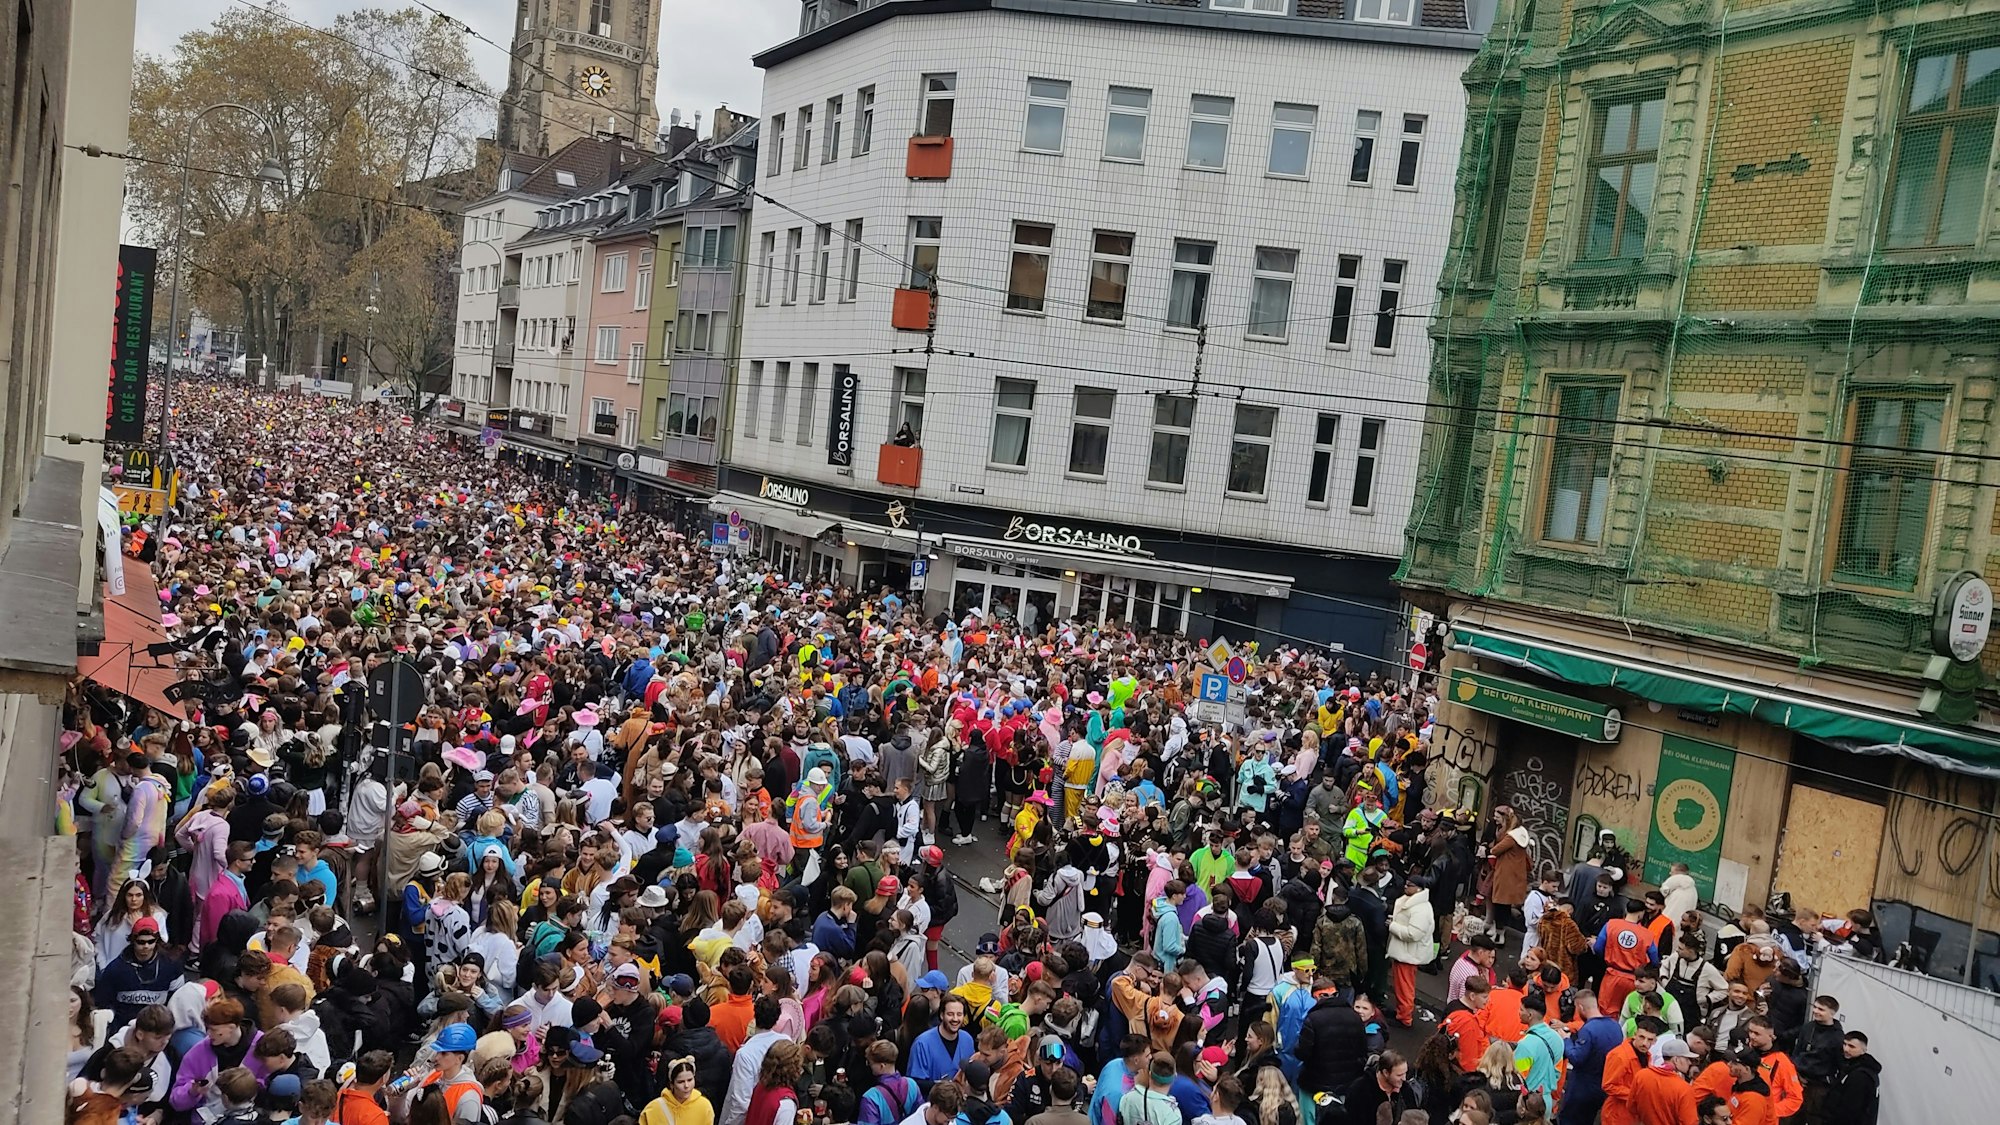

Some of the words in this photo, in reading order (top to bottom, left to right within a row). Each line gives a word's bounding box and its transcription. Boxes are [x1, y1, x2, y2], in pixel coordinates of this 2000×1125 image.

[126, 271, 145, 349] RESTAURANT
[124, 359, 138, 382] BAR
[120, 391, 136, 423] CAFÉ
[833, 376, 854, 464] BORSALINO
[759, 475, 809, 506] BORSALINO
[1004, 515, 1142, 554] BORSALINO
[954, 545, 1014, 561] BORSALINO
[914, 562, 923, 576] P
[1958, 604, 1984, 621] Sünner
[1206, 677, 1222, 698] P
[1483, 687, 1499, 699] BEI
[1501, 692, 1525, 706] OMA
[1528, 699, 1592, 722] KLEINMANN
[1663, 749, 1674, 757] BEI
[1675, 752, 1690, 761] OMA
[1691, 755, 1731, 771] KLEINMANN
